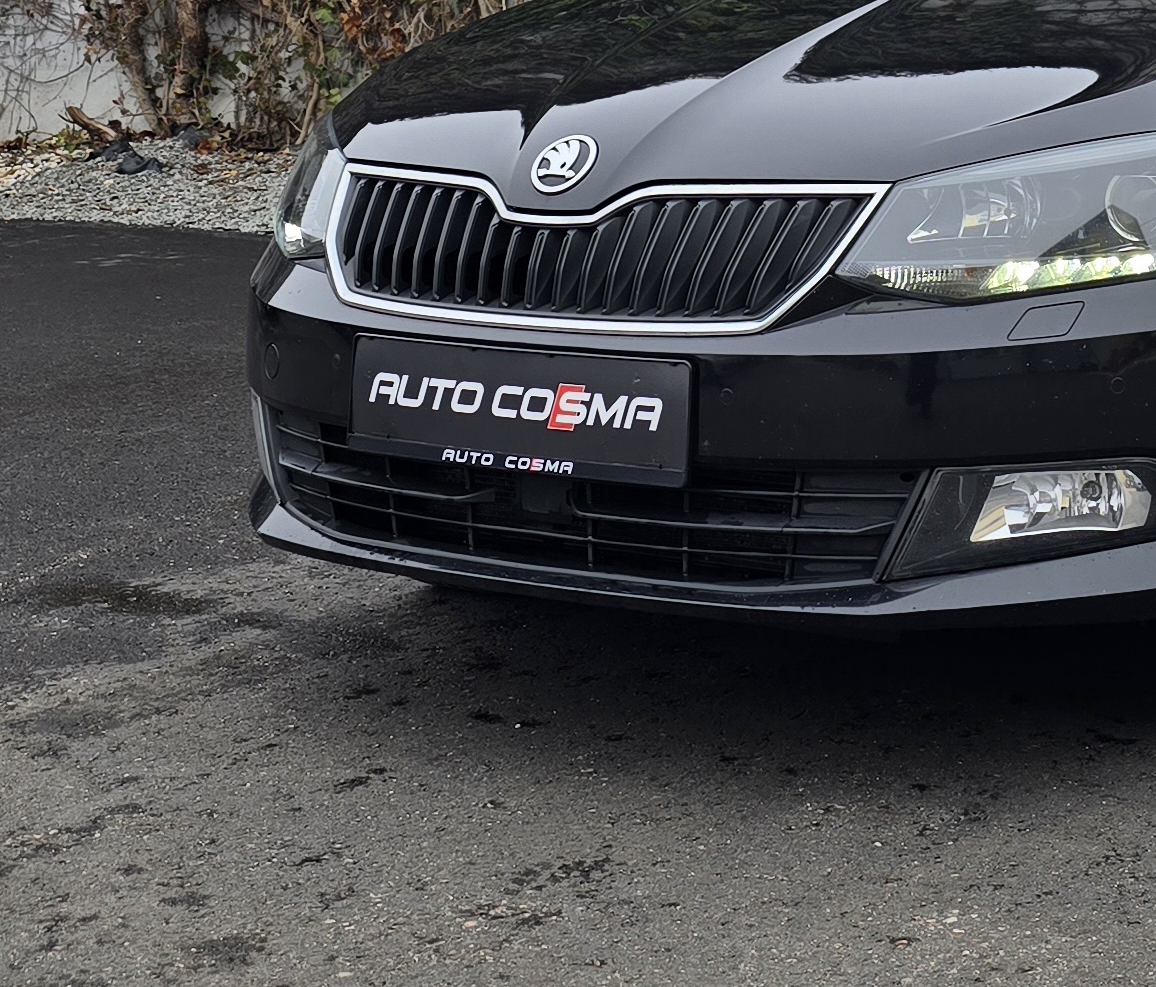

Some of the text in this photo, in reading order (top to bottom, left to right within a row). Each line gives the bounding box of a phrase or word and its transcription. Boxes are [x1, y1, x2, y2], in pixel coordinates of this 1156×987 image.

[368, 371, 663, 431] AUTO COSMA
[441, 449, 574, 475] AUTO COSMA
